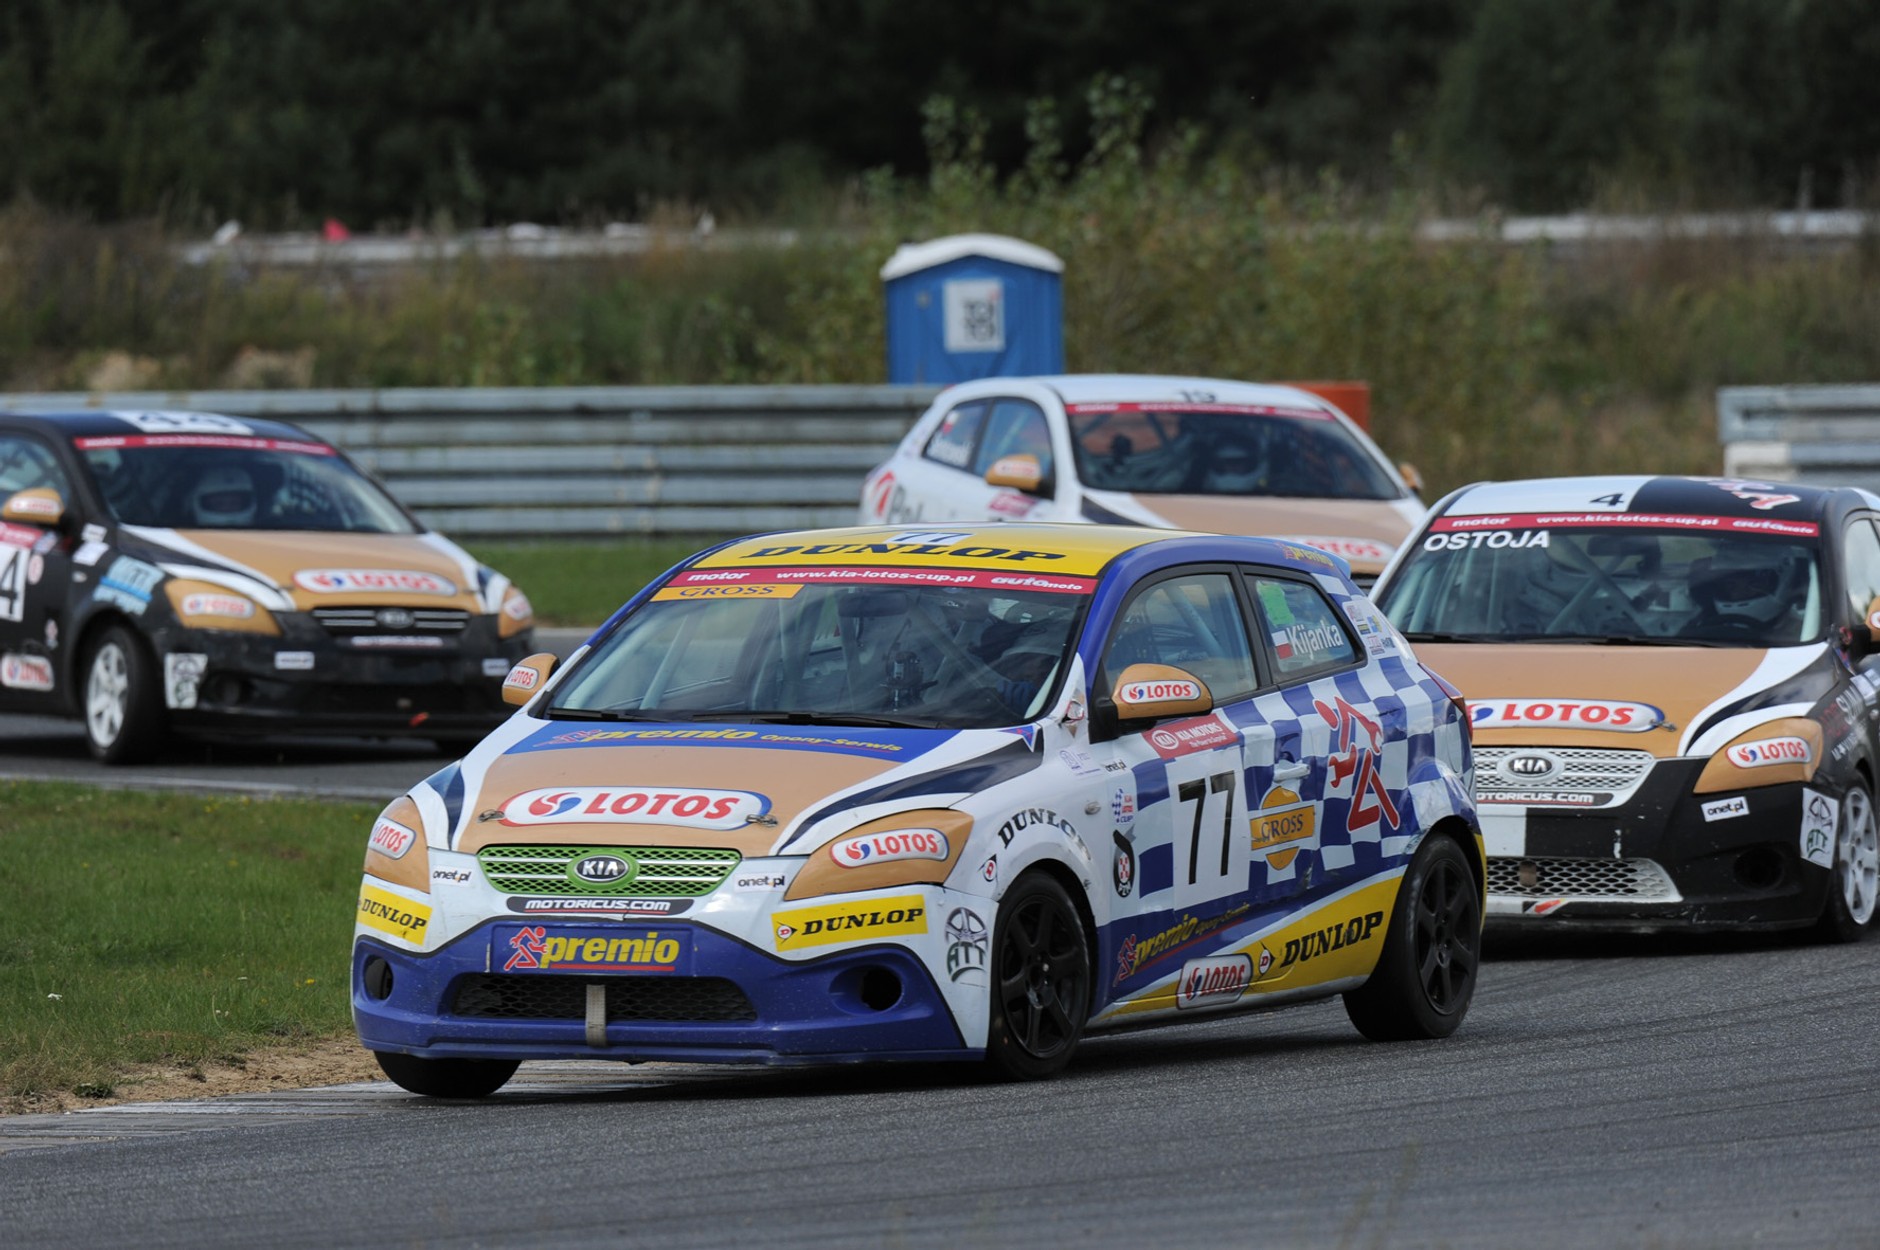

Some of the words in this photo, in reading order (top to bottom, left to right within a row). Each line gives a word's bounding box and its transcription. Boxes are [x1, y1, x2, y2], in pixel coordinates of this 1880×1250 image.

[1589, 493, 1624, 507] 4
[1452, 516, 1510, 527] motor
[893, 531, 974, 543] 77
[1423, 530, 1551, 552] OSTOJA
[741, 542, 1066, 562] DUNLOP
[348, 573, 440, 591] LOTOS
[686, 571, 750, 582] motor
[776, 569, 976, 584] www.kia-lotos-cup.pl
[680, 585, 775, 598] GROSS
[1286, 620, 1344, 660] Kijanka
[1147, 684, 1191, 699] LOTOS
[1502, 704, 1634, 725] LOTOS
[583, 729, 759, 742] premio
[760, 734, 903, 751] Opony-Serwis
[1759, 739, 1805, 760] LOTOS
[1513, 760, 1549, 773] KIA
[585, 792, 740, 820] LOTOS
[1476, 792, 1594, 805] OTORICUS.COM
[1707, 801, 1745, 815] onet.pl
[1178, 770, 1236, 885] 77
[1261, 814, 1304, 842] GROSS
[374, 824, 408, 853] LOTOS
[875, 832, 938, 856] LOTOS
[432, 869, 471, 882] onet.pl
[582, 860, 618, 877] KIA
[737, 874, 785, 888] onet.pl
[362, 898, 426, 931] DUNLOP
[802, 908, 923, 937] DUNLOP
[1130, 913, 1198, 976] premio
[1280, 911, 1383, 968] DUNLOP
[539, 932, 680, 969] premio
[1200, 965, 1246, 997] LOTOS
